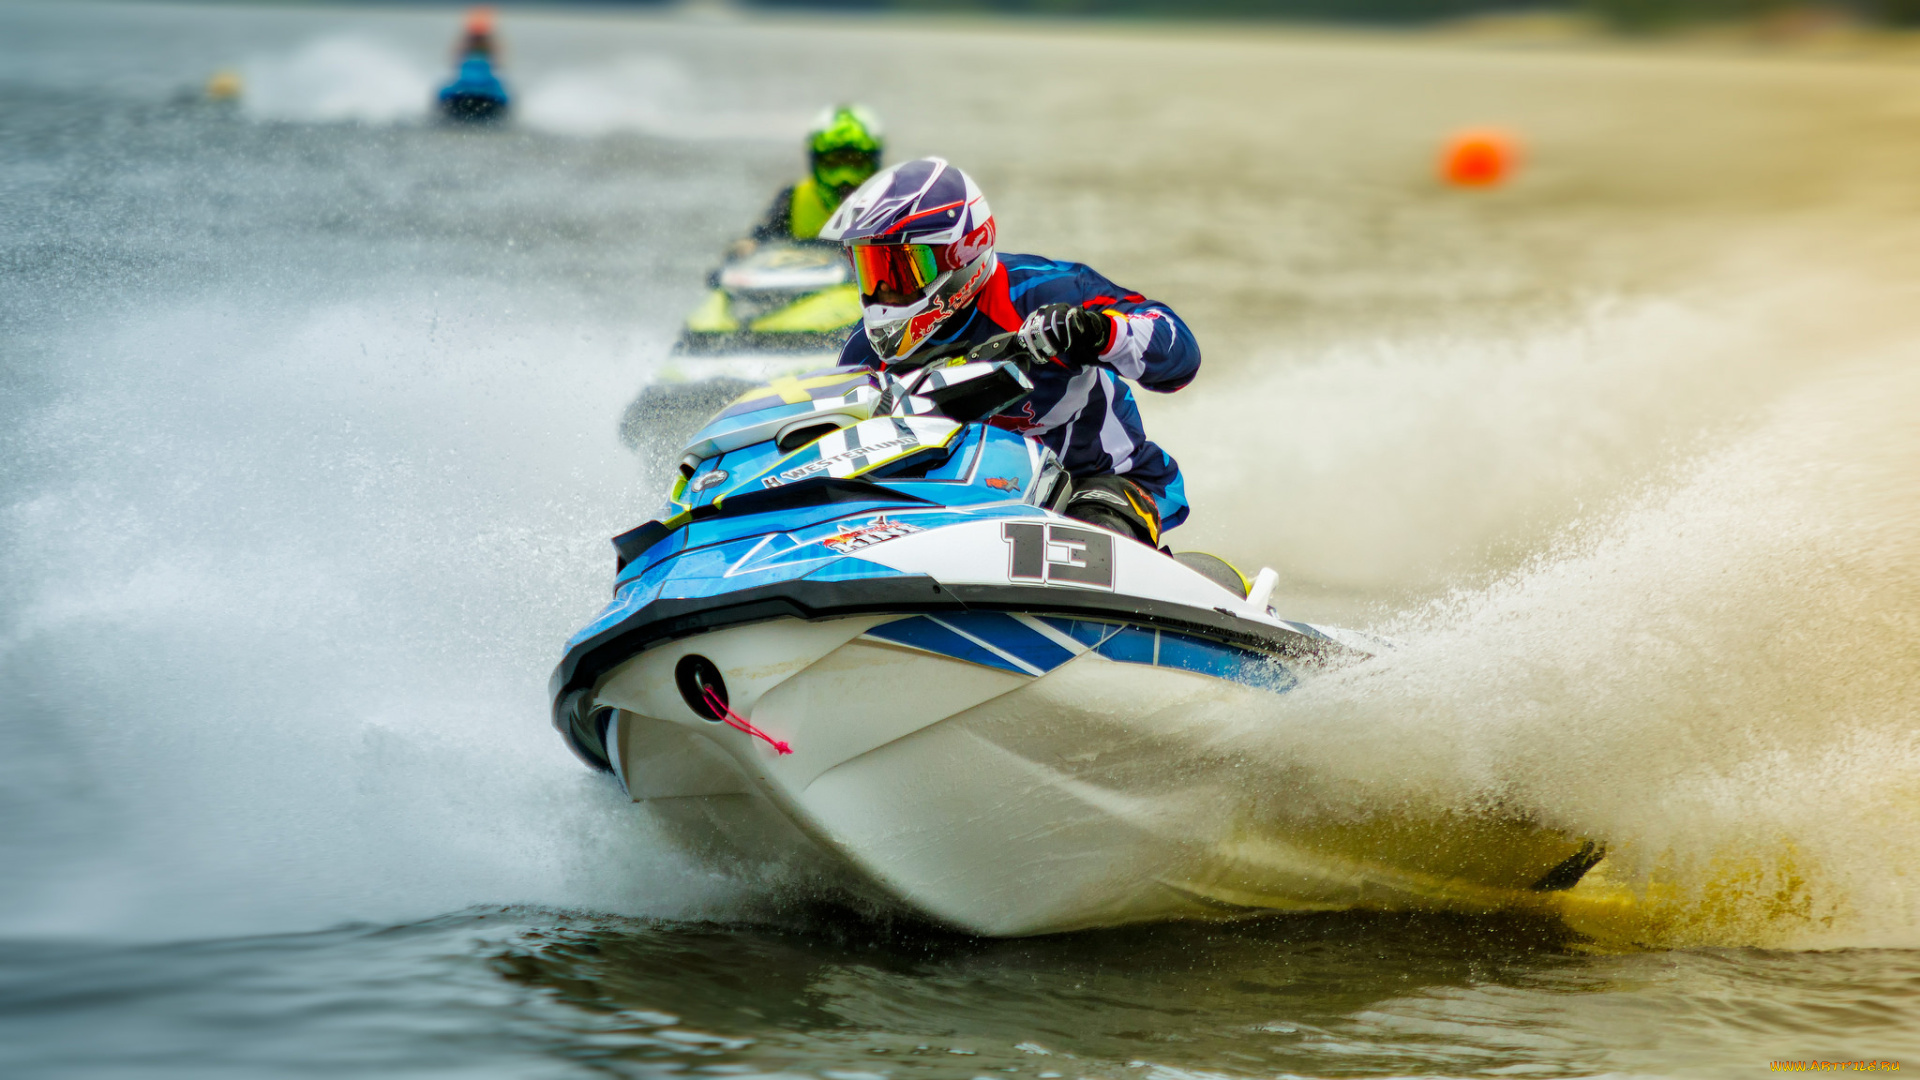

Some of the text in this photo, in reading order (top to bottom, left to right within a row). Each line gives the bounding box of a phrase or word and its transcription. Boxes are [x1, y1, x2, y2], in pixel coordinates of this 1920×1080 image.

[761, 436, 919, 489] H WESTERLUND
[1003, 521, 1114, 590] 13
